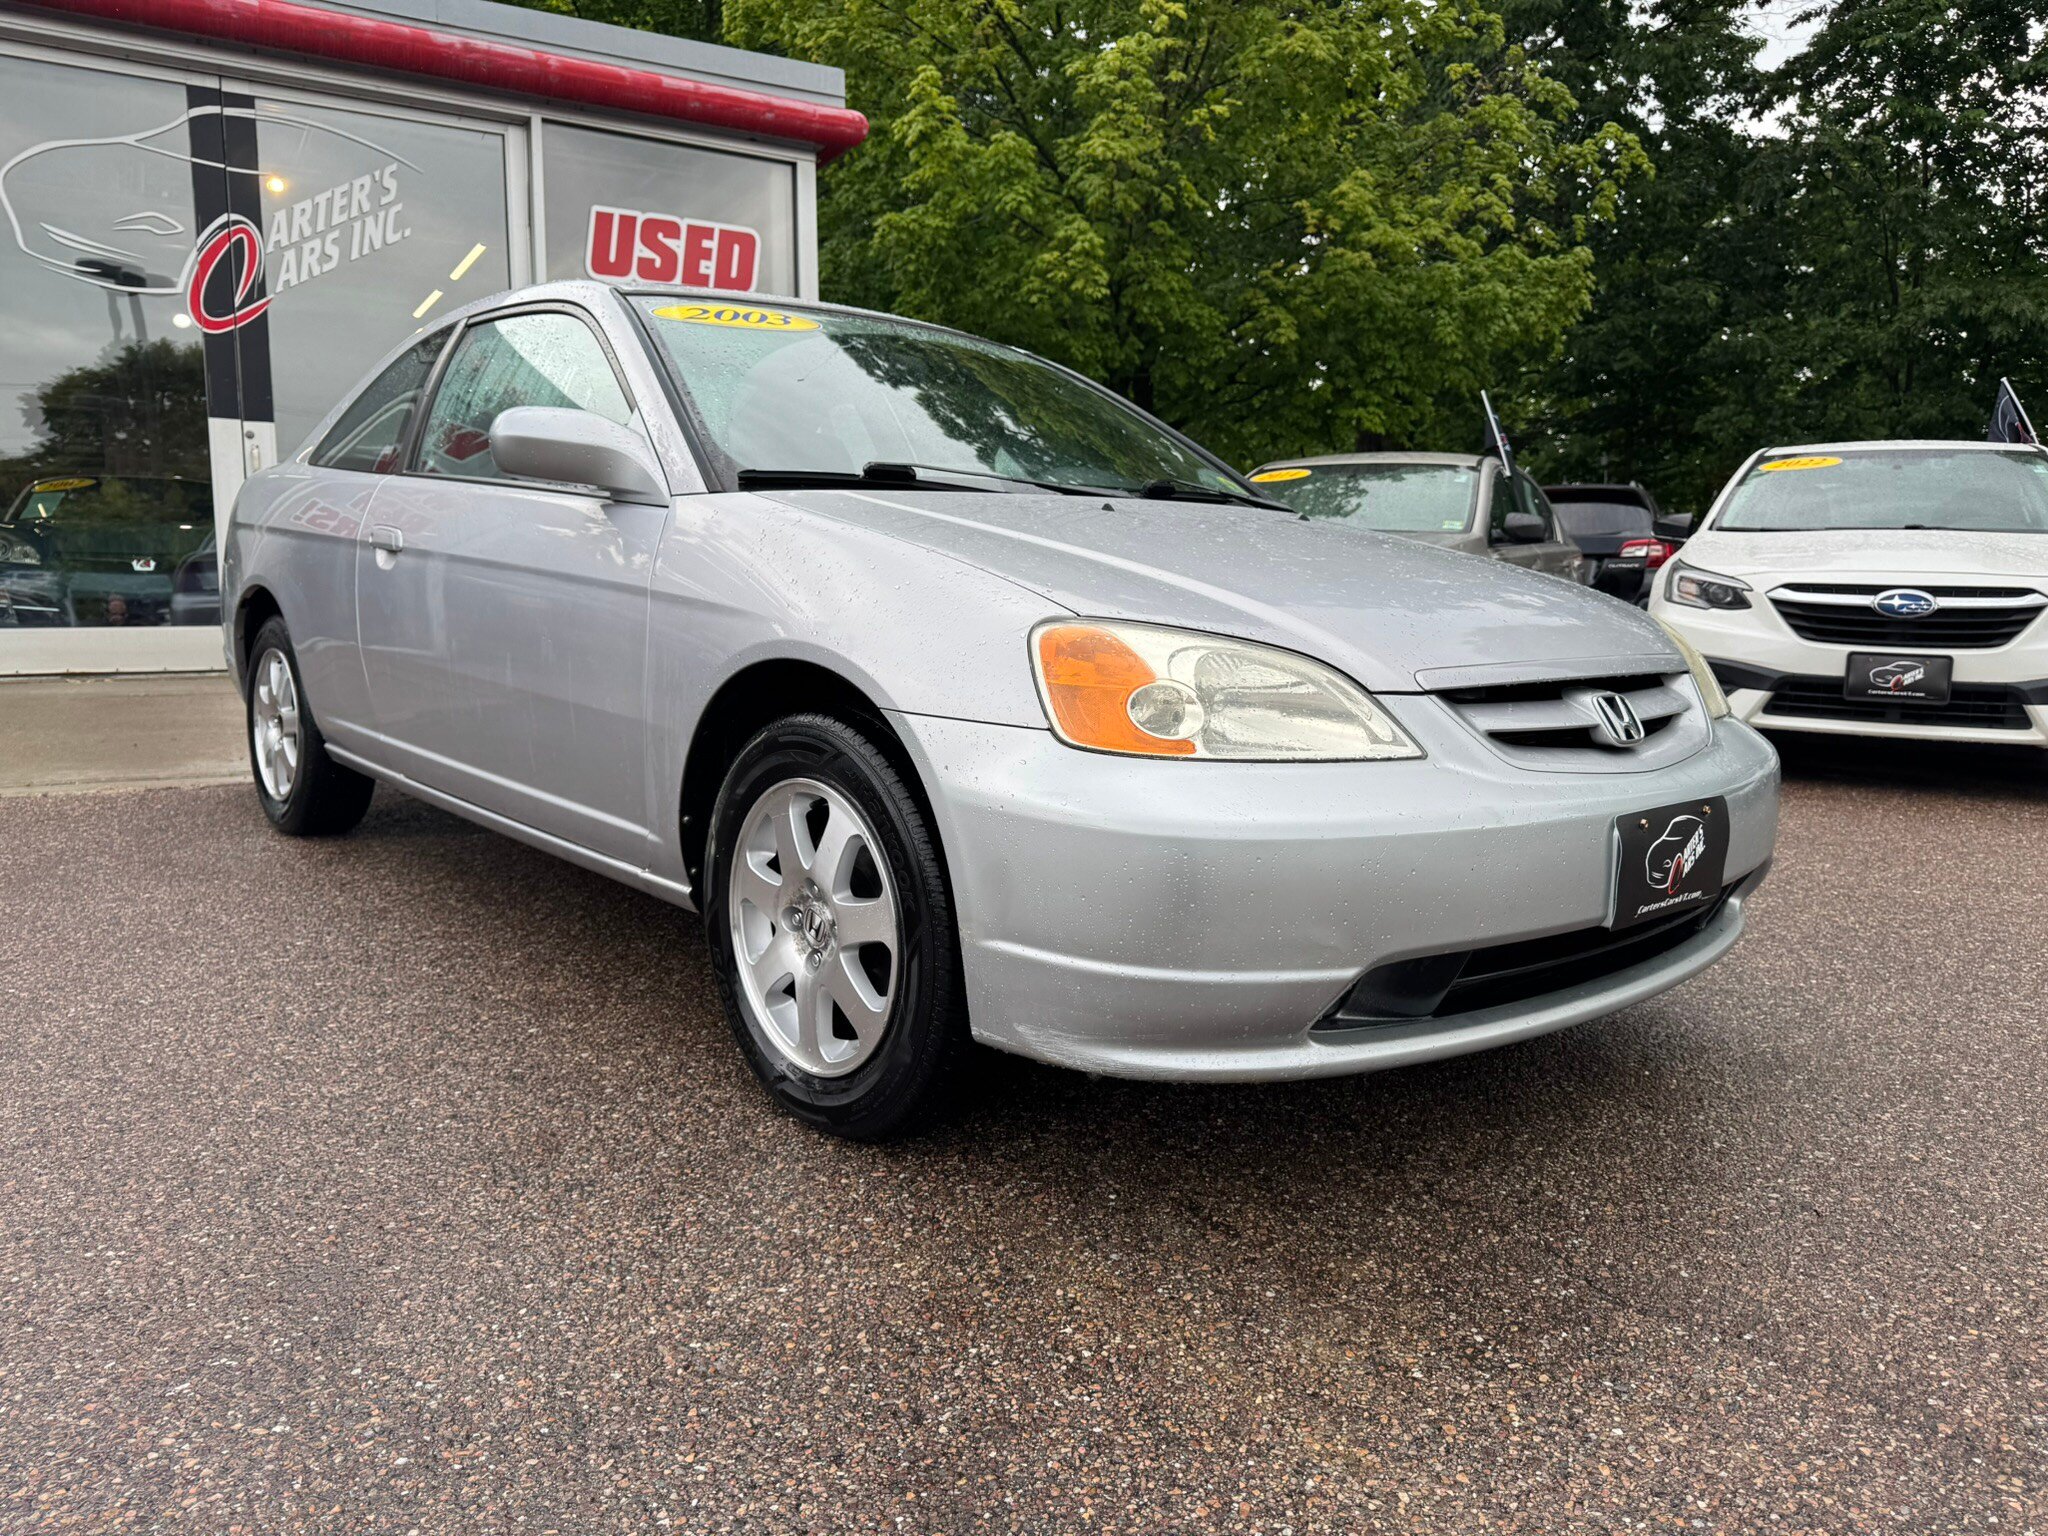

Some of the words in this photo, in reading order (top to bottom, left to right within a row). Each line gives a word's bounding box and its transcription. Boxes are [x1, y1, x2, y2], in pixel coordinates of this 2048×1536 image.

[350, 203, 412, 261] INC.
[590, 210, 757, 292] USED
[683, 306, 792, 327] 2003
